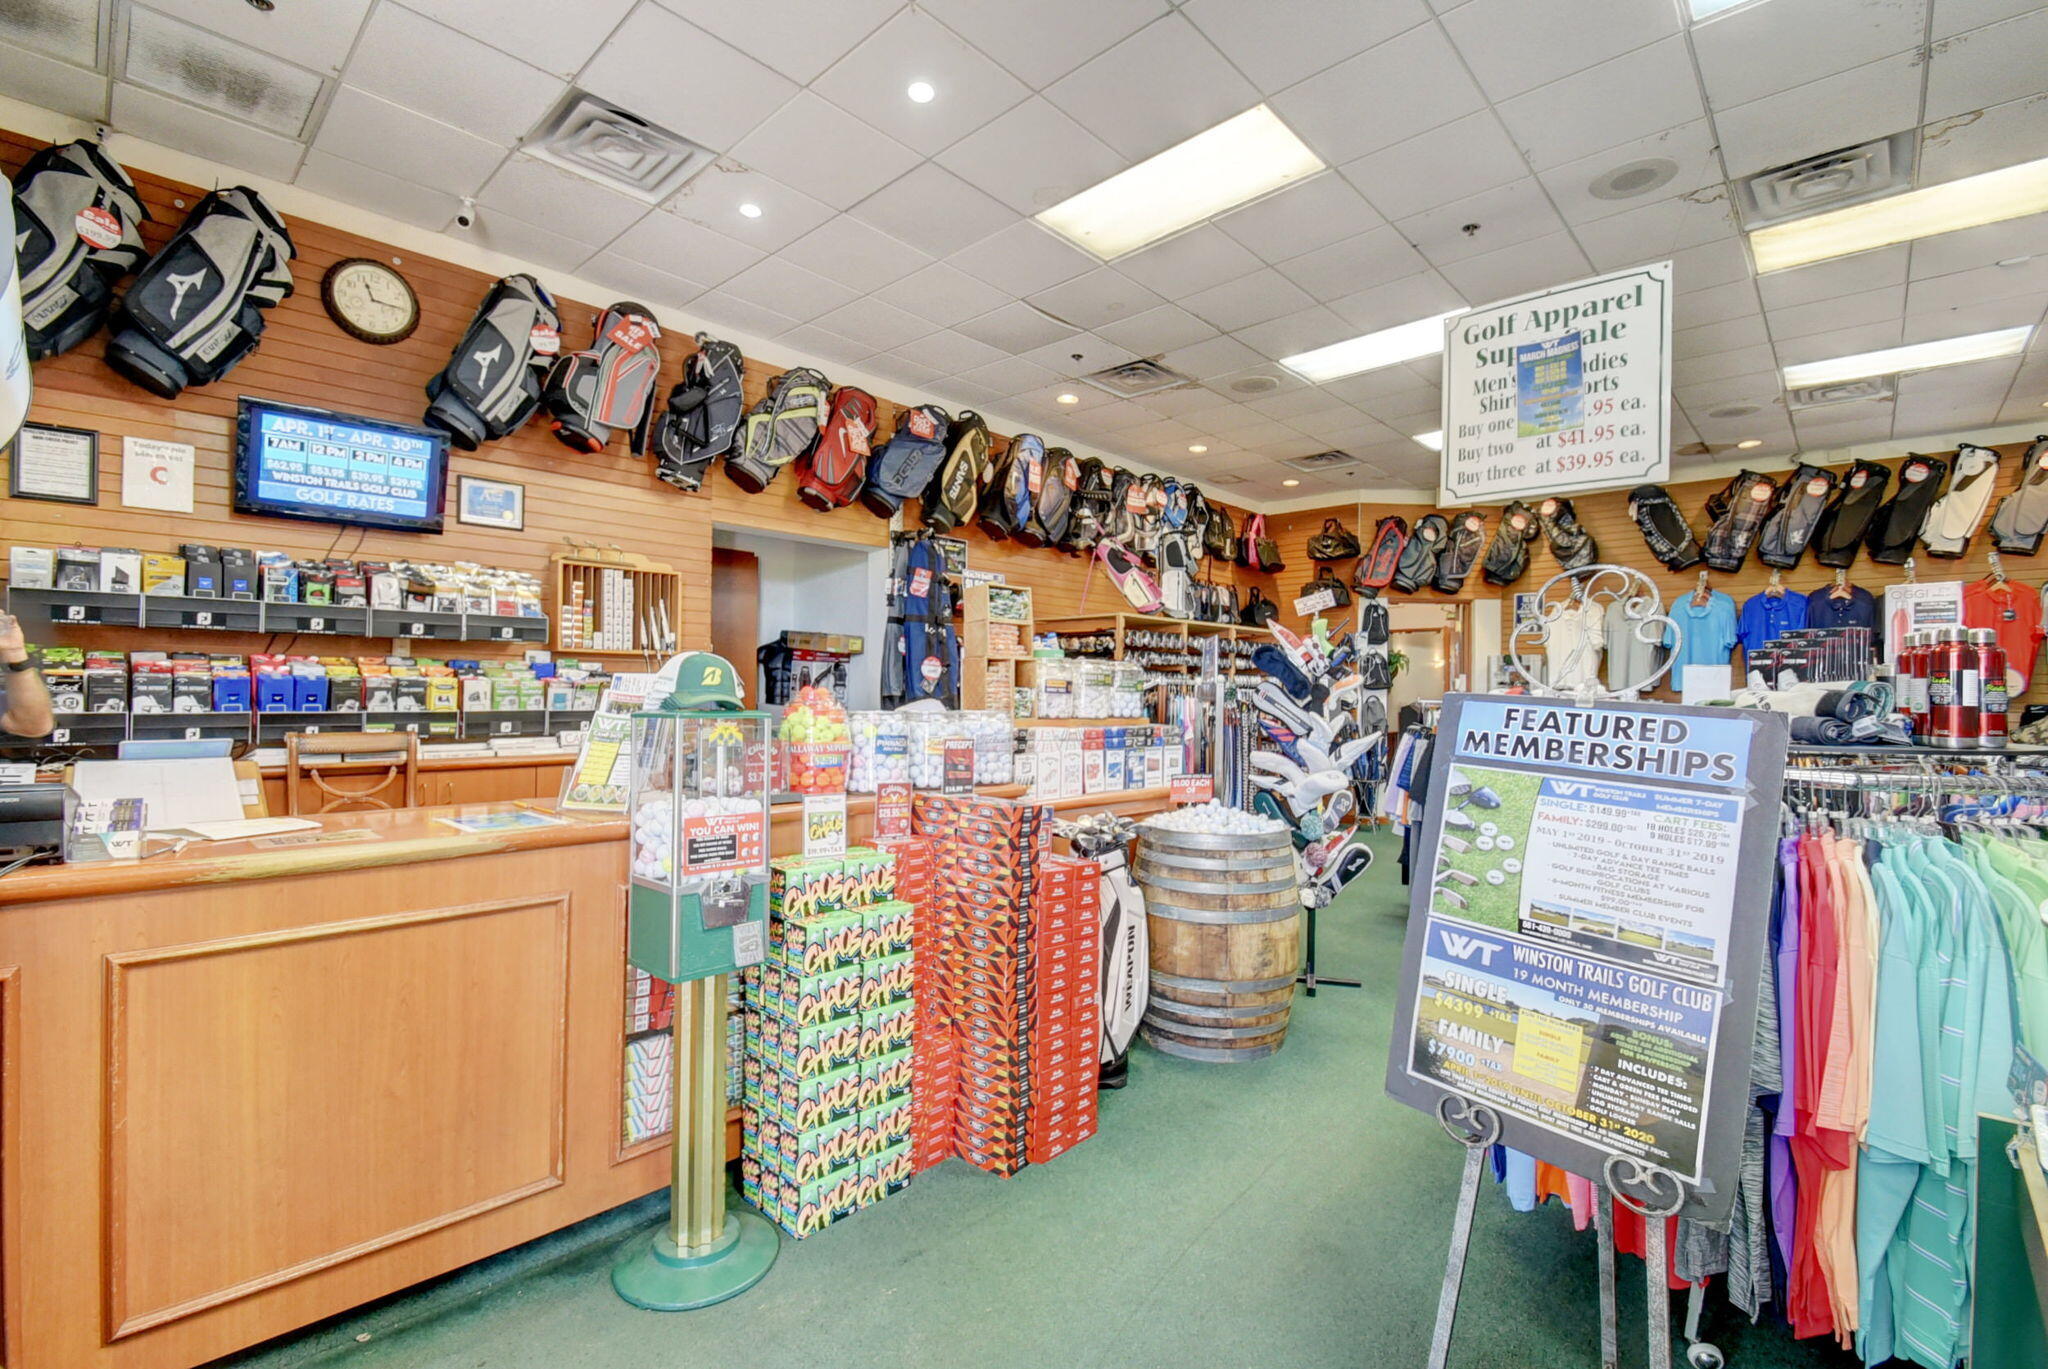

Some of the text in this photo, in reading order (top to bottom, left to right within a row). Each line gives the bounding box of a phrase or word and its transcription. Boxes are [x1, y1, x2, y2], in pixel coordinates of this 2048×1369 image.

[83, 209, 120, 232] Sale
[1463, 284, 1643, 346] Golf Apparel
[614, 329, 643, 350] SALE
[1519, 341, 1579, 363] MARCH MADNESS
[271, 418, 313, 437] APR.
[349, 432, 388, 449] APR.
[1458, 397, 1646, 439] Buy one ea.
[325, 447, 347, 459] PM
[365, 452, 386, 464] PM
[1457, 423, 1646, 463] Buy two at $41.95 ea.
[404, 459, 424, 470] PM
[1457, 449, 1646, 487] Buy three at $39.95 ea.
[272, 470, 418, 500] WINSTON TRAILS GOLF CLUB
[296, 488, 396, 511] GOLF RATES
[1891, 589, 1929, 599] OGGI
[1502, 707, 1690, 745] FEATURED
[944, 740, 974, 750] PRECEPT
[1462, 730, 1736, 782] MEMBERSHIPS
[1191, 779, 1211, 787] EACH
[1550, 780, 1595, 798] WT
[1538, 811, 1585, 827] FAMILY:
[1540, 798, 1588, 813] SINGLE:
[1653, 813, 1728, 832] CART FEES:
[689, 821, 760, 838] YOU CAN WIN!
[1535, 826, 1725, 866] MAY 2019 OCTOBER 2019
[1657, 824, 1686, 836] HOLES
[1658, 833, 1686, 844] HOLES
[1552, 841, 1717, 877] UNLIMITED GOLF DAY RANGE BALLS
[1596, 864, 1661, 883] BAG STORAGE
[1601, 857, 1644, 872] ADVANCE
[783, 872, 845, 919] CHAOS
[842, 862, 896, 906] CHAOS
[1551, 863, 1575, 874] GOLF
[1666, 884, 1711, 900] VARIOUS
[1596, 879, 1652, 896] GOLF CLUBS
[1558, 893, 1694, 928] SUMMER MEMBER CLUB EVENTS
[1626, 890, 1685, 910] MEMBERSHIP
[1686, 904, 1706, 914] FOR
[803, 924, 864, 976] CHAOS
[859, 912, 914, 963] CHAOS
[1440, 929, 1505, 967] WT
[859, 961, 914, 1010] CHAOS
[1122, 923, 1136, 1012] WEAPON
[1512, 944, 1574, 976] WINSTON
[1577, 960, 1625, 992] TRAILS
[1628, 975, 1669, 1001] GOLF
[1672, 985, 1713, 1012] CLUB
[797, 974, 862, 1028] CHAOS
[1434, 990, 1485, 1019] $4399
[1444, 970, 1510, 1005] SINGLE
[1513, 967, 1685, 1024] 19 MONTH MEMBERSHIP
[859, 1008, 915, 1060] CHAOS
[1437, 1018, 1506, 1054] FAMILY
[1558, 994, 1708, 1045] ONLY MEMBERSHIPS AVAILABLE
[796, 1025, 861, 1079] CHAOS
[1427, 1038, 1477, 1067] $7900
[1631, 1029, 1674, 1049] BONUS:
[857, 1055, 914, 1109] CHAOS
[1600, 1068, 1616, 1079] DAY
[1616, 1073, 1656, 1091] ADVANCED
[1669, 1090, 1692, 1104] TIMES
[1617, 1057, 1689, 1090] INCLUDES:
[796, 1076, 861, 1131] CHAOS
[1443, 1060, 1657, 1145] APRIL UNTIL OCTOBER 2020
[1591, 1089, 1629, 1107] UNLIMITED
[1591, 1081, 1682, 1118] MONDAY SUNDAY PLAY
[1593, 1074, 1613, 1087] CART
[1660, 1095, 1700, 1115] INCLUDED
[857, 1101, 913, 1160] CHAOS
[1588, 1103, 1637, 1127] GOLF LOCKER
[796, 1126, 859, 1184] CHAOS
[857, 1147, 913, 1206] CHAOS
[796, 1172, 859, 1238] CHAOS
